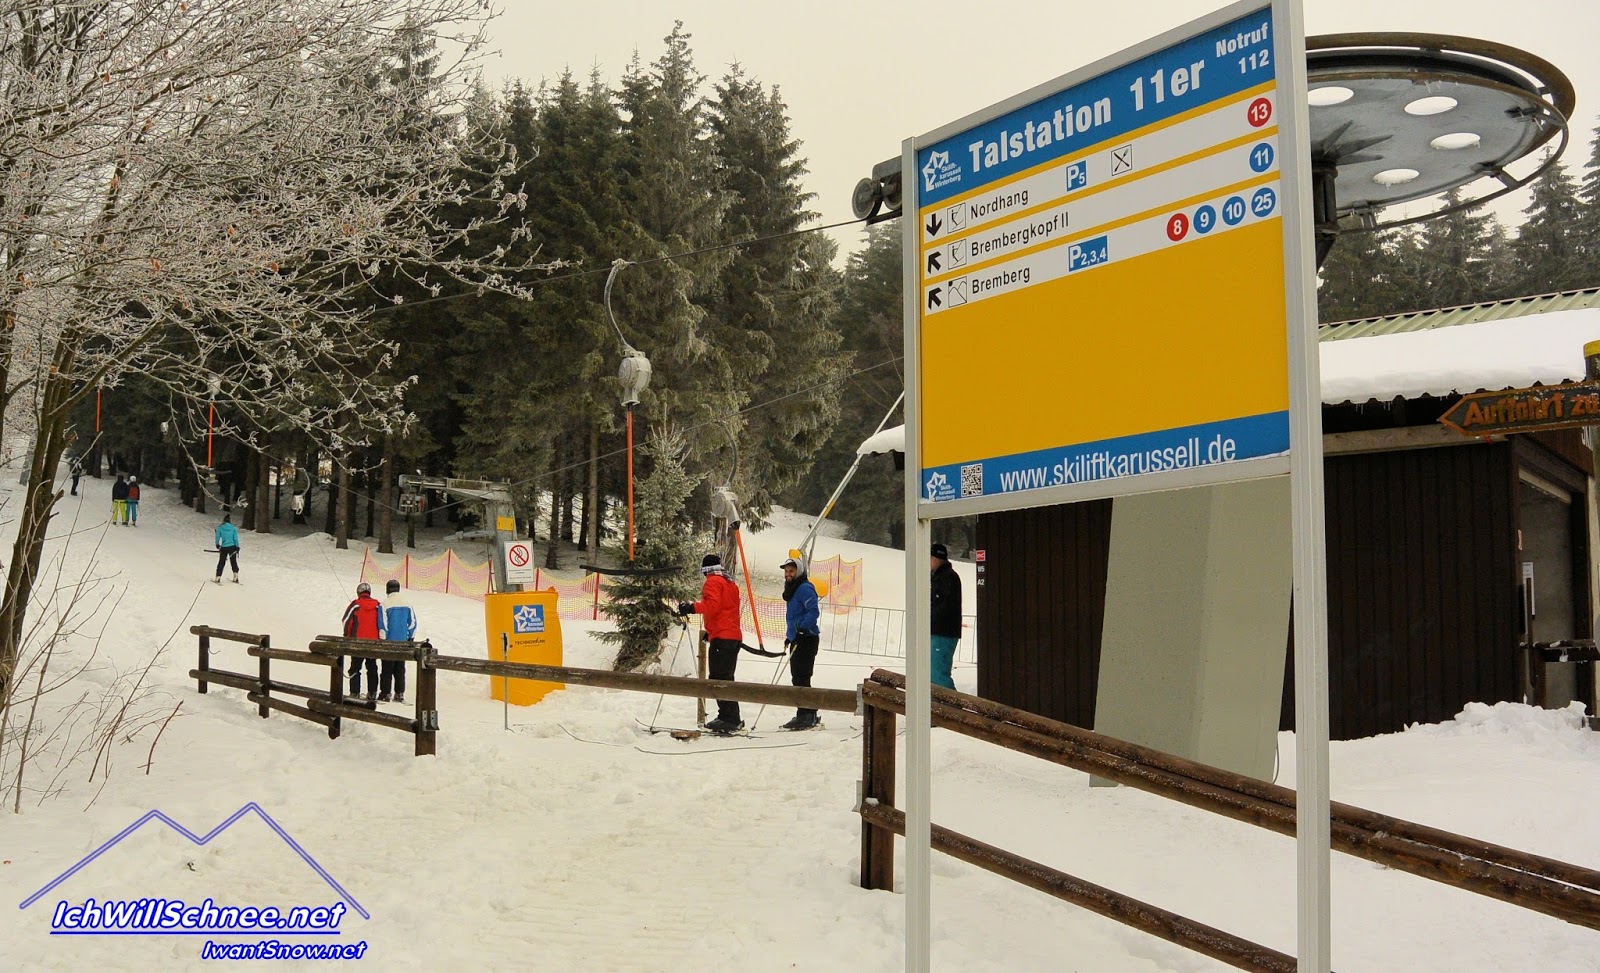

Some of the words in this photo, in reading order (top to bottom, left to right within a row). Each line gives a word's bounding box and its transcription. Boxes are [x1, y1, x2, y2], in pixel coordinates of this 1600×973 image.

[1215, 22, 1269, 58] Notruf
[1238, 49, 1270, 75] 112
[968, 96, 1112, 174] Talstation
[1130, 58, 1205, 112] 11er
[1250, 102, 1269, 122] 13
[1254, 149, 1269, 167] 11
[934, 174, 961, 189] Winterberg
[970, 188, 1029, 220] Nordhang
[1172, 219, 1183, 236] 8
[1199, 211, 1210, 228] 9
[1226, 201, 1243, 219] 10
[1254, 192, 1273, 212] 25
[971, 214, 1059, 257] Brembergkopf
[972, 264, 1031, 295] Bremberg
[1463, 392, 1564, 427] Auffahrt
[999, 433, 1237, 492] www.skiliftkarussell.de
